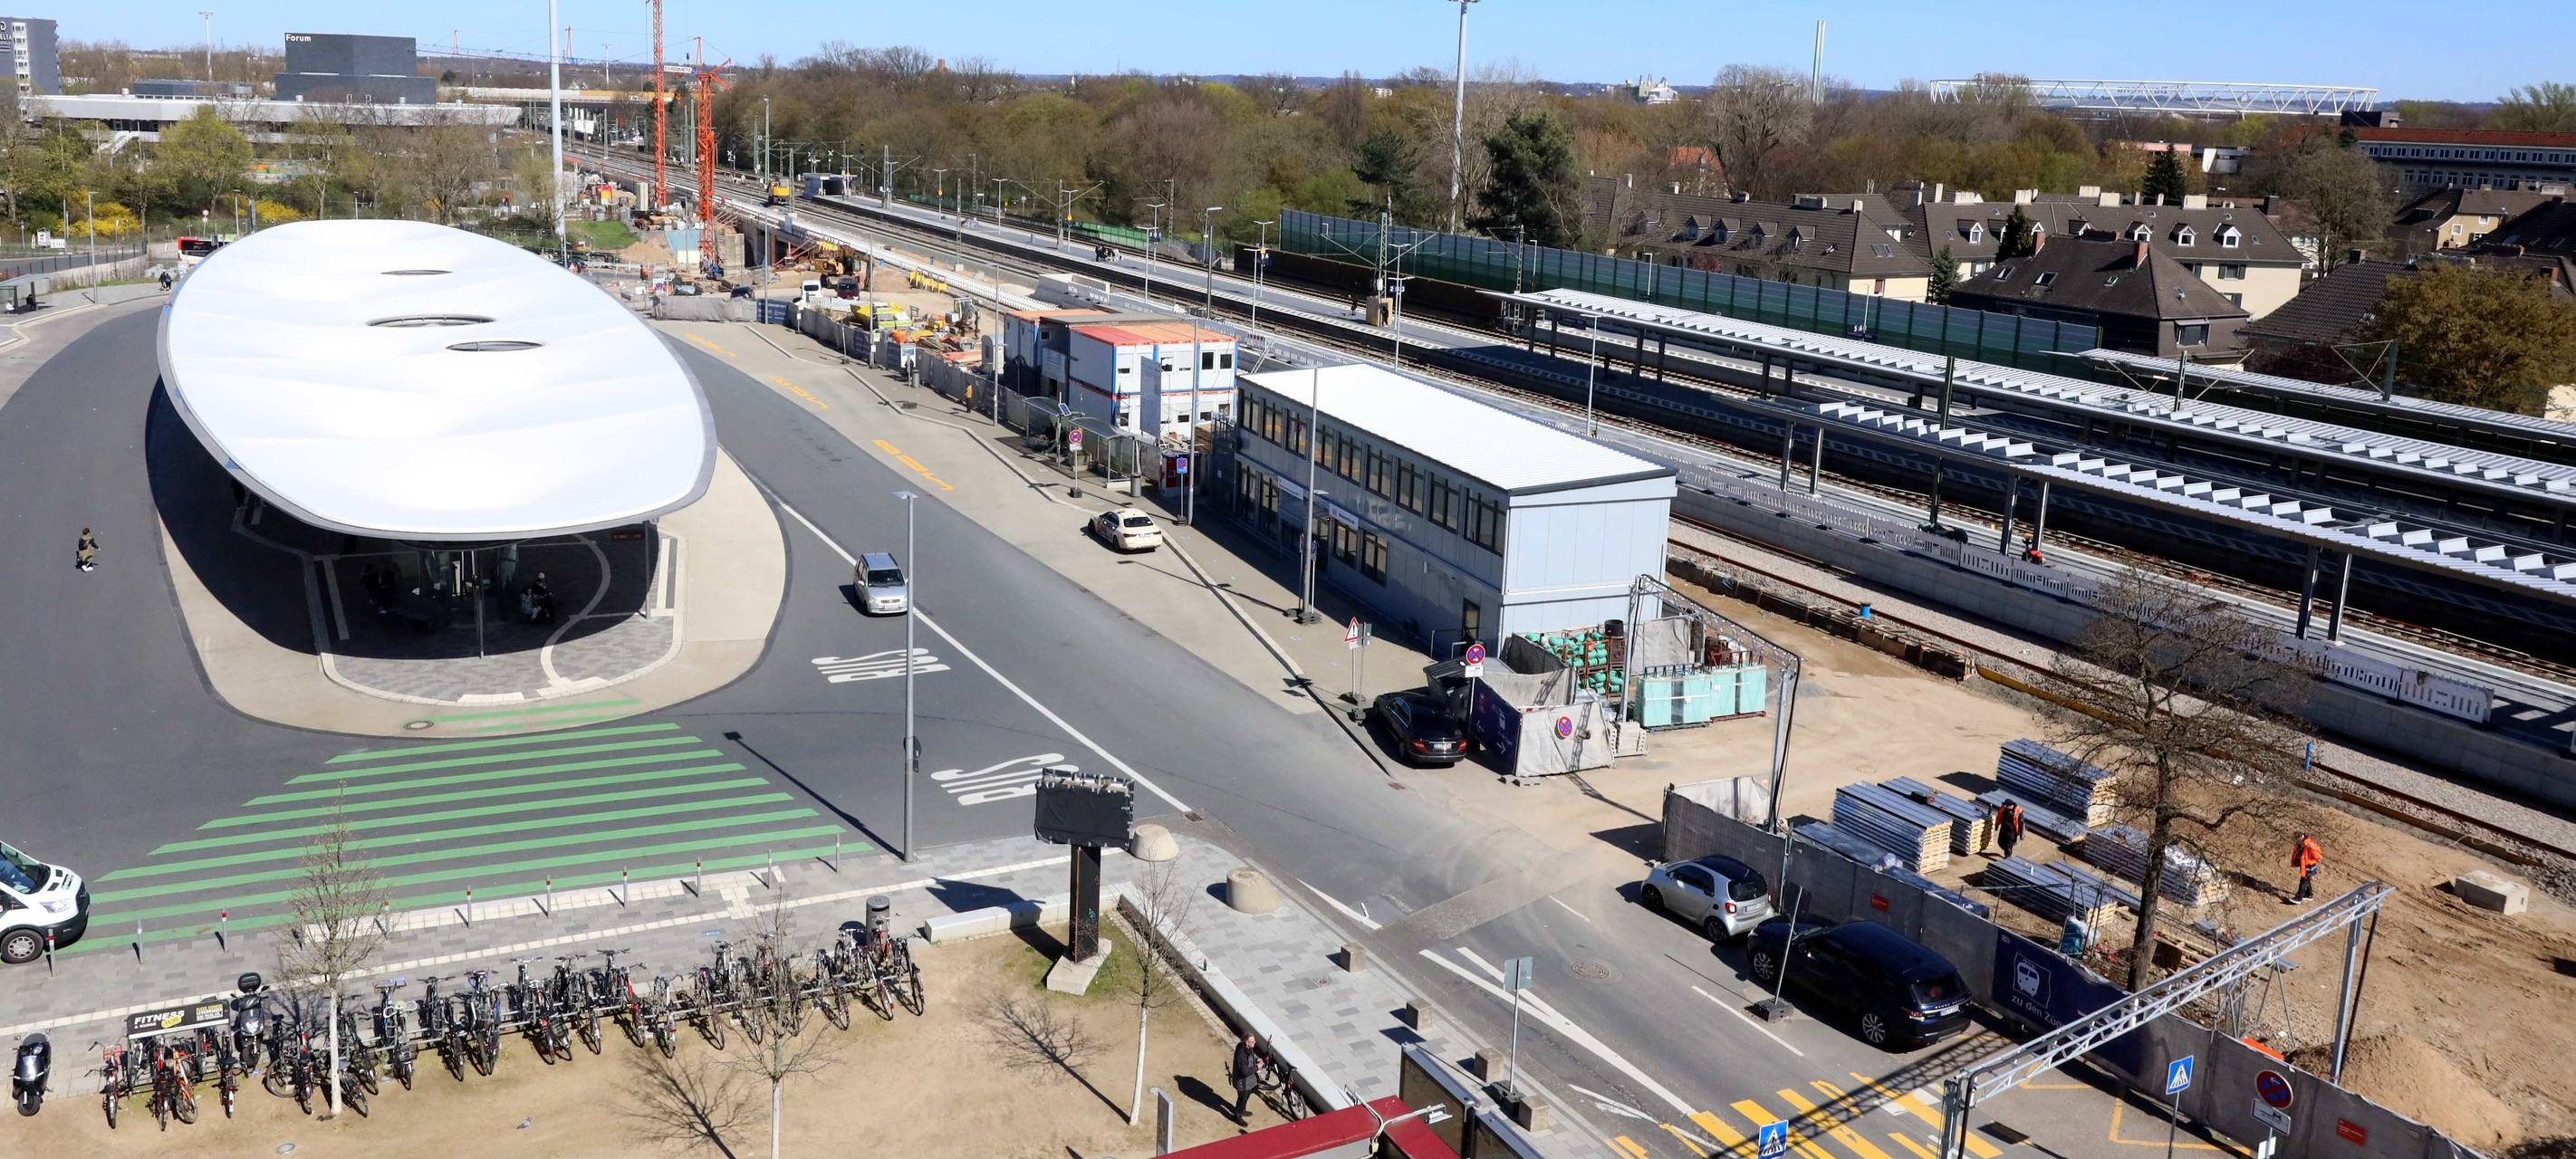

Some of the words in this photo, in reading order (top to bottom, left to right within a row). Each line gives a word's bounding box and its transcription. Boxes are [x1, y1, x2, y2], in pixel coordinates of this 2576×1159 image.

[285, 34, 312, 42] Forum
[769, 376, 831, 411] BUS
[872, 438, 955, 492] BUS
[811, 647, 951, 684] BUS
[930, 752, 1080, 806] BUS
[133, 1010, 185, 1025] FITNESS
[2011, 995, 2023, 1007] zu
[2025, 1001, 2043, 1018] den
[2044, 1011, 2065, 1029] Züg
